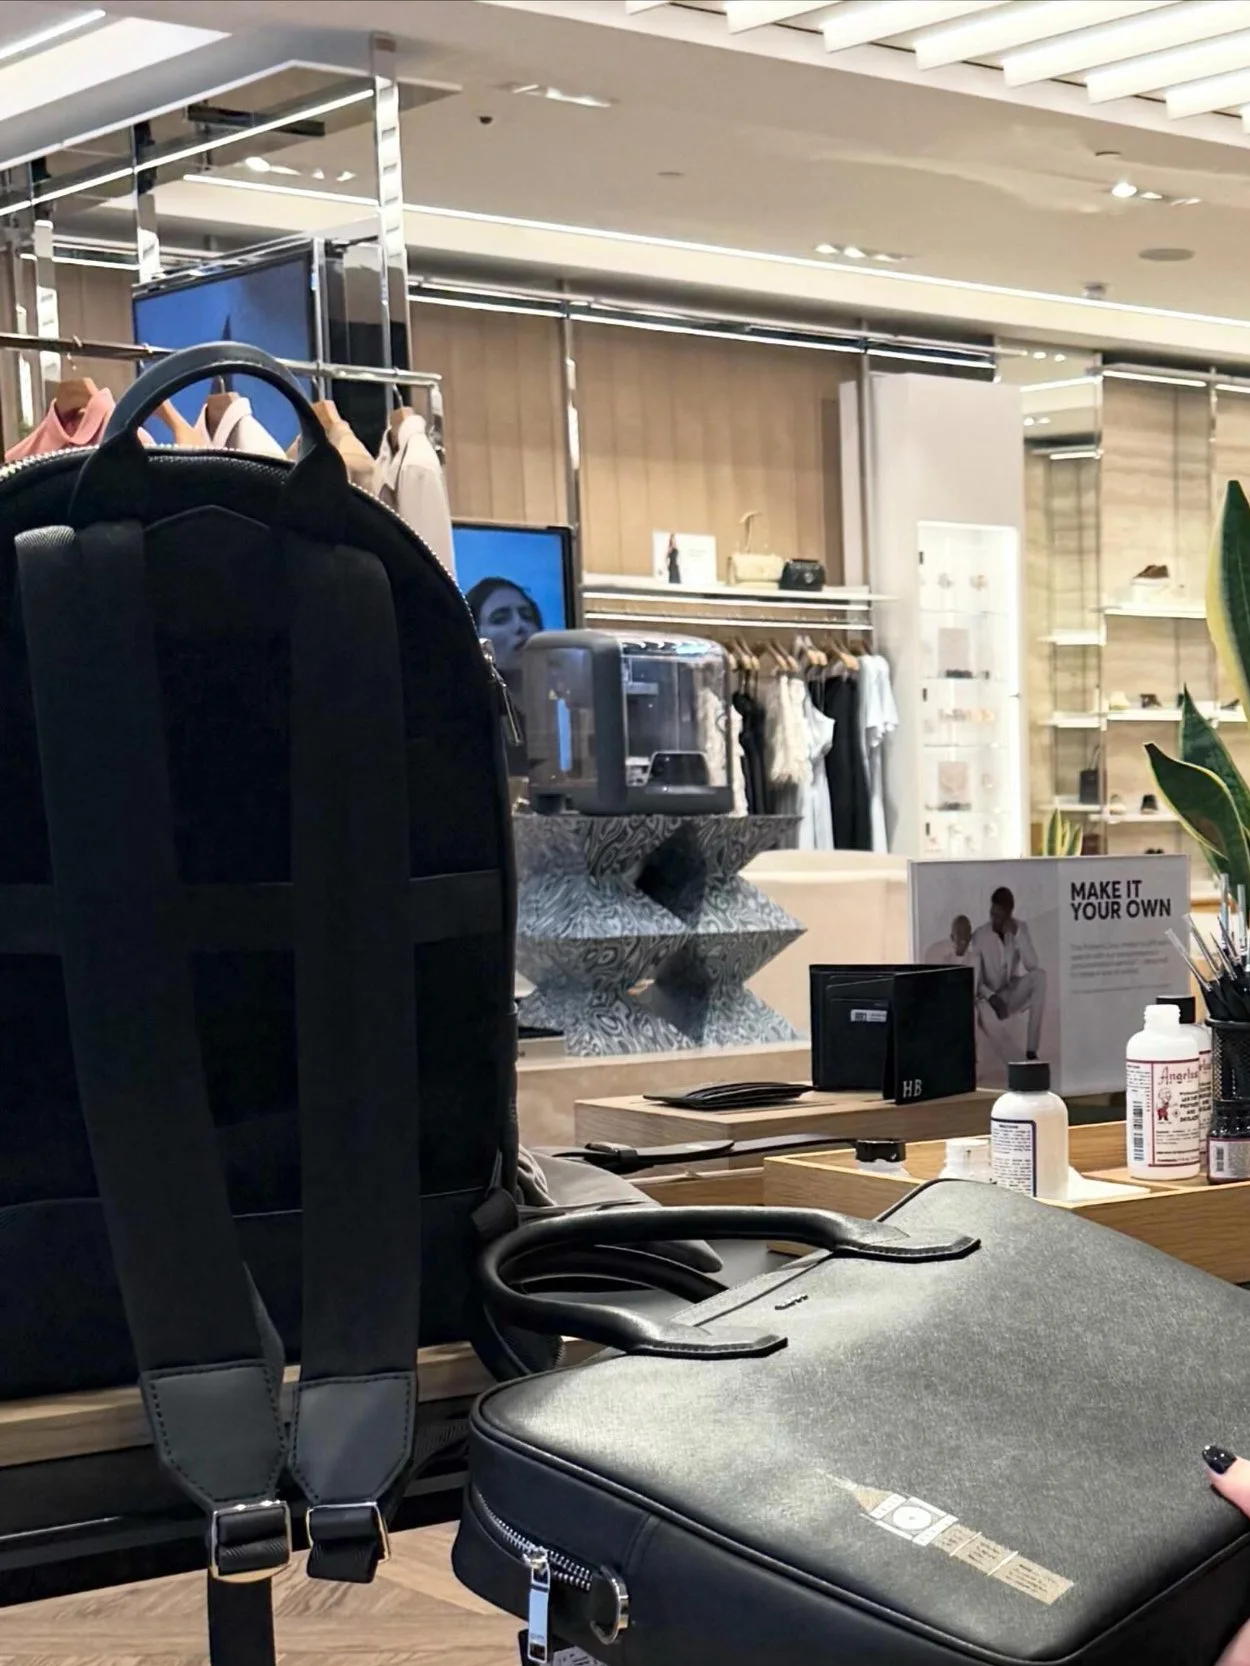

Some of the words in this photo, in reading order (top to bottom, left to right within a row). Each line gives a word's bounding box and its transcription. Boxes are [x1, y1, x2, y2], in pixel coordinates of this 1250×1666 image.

[1070, 880, 1122, 901] MAKE
[1126, 879, 1142, 899] IT
[1070, 900, 1122, 921] YOUR
[1126, 898, 1171, 918] OWN
[902, 1078, 923, 1098] HB
